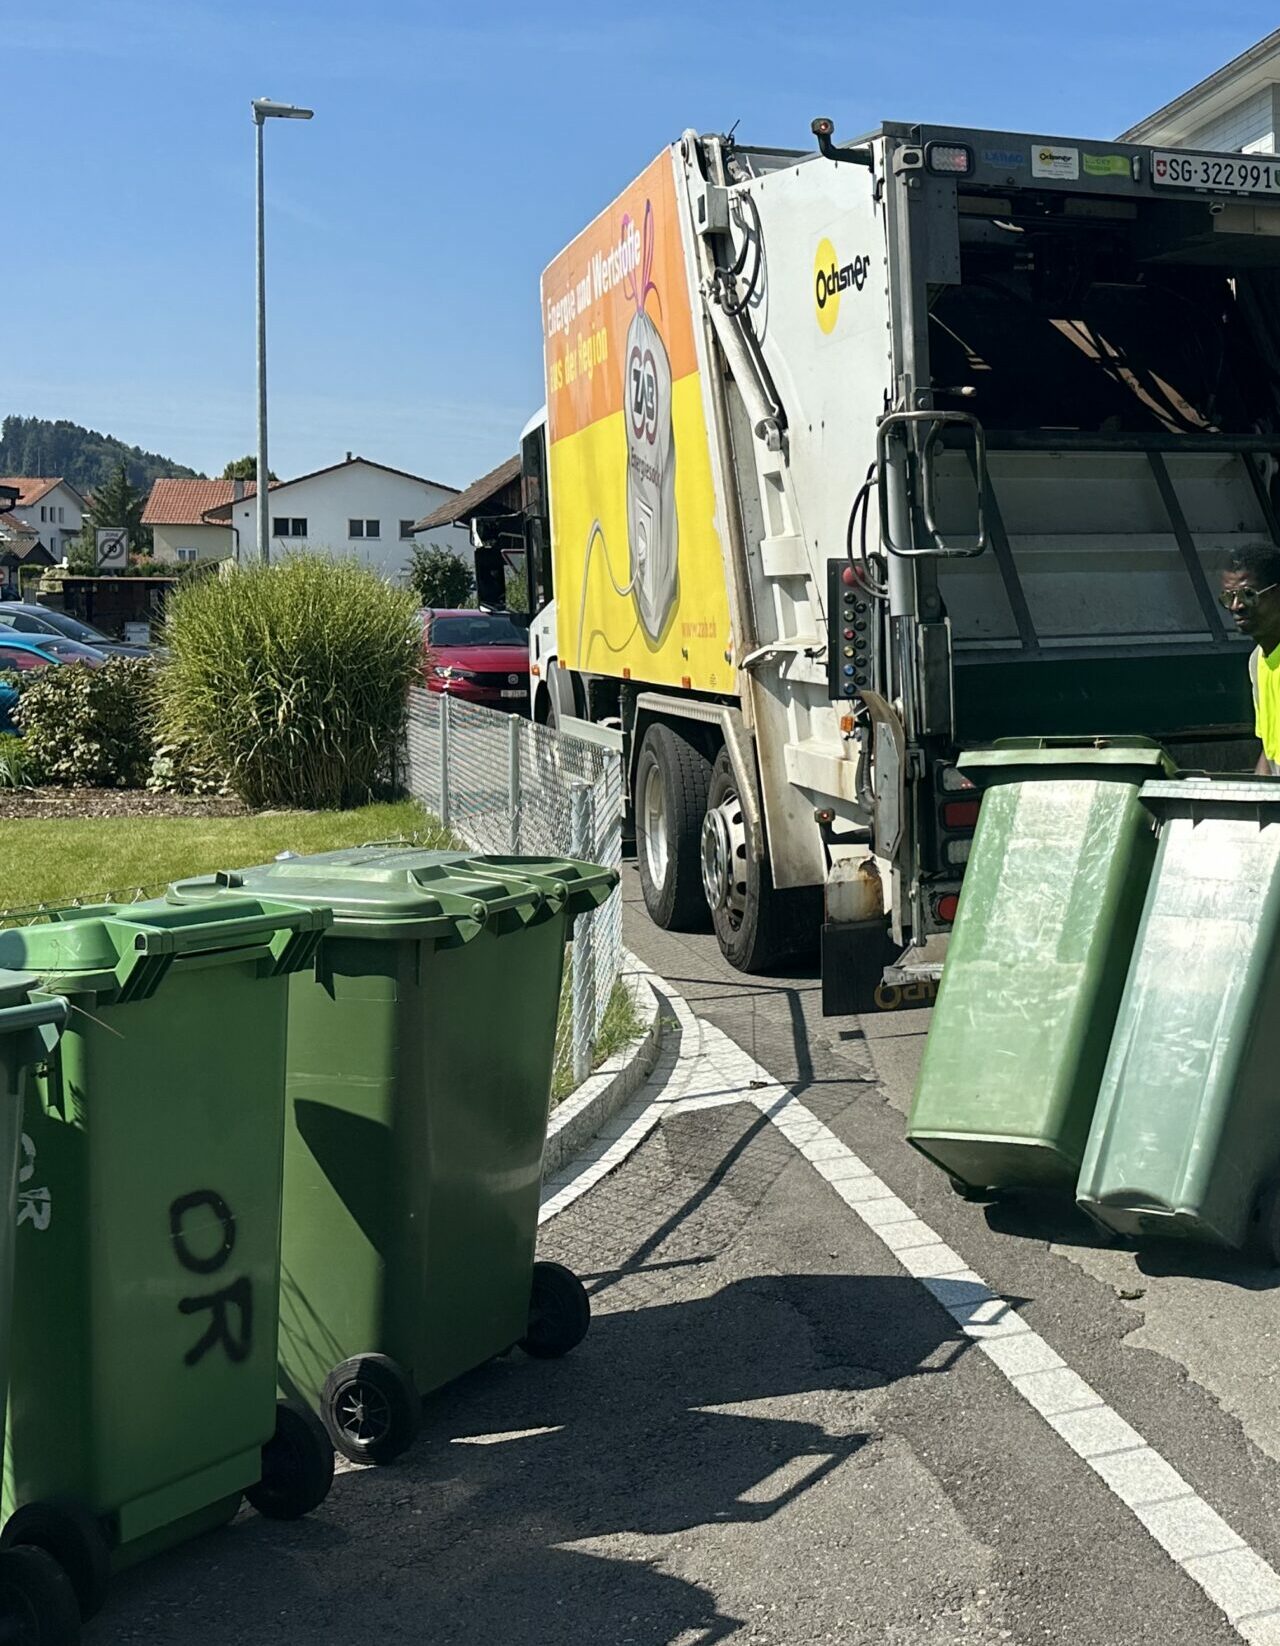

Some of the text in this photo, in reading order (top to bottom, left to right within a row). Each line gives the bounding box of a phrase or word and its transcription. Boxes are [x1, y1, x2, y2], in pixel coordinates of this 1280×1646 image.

[547, 219, 641, 338] Energie und Wertstoffe
[816, 255, 870, 309] Ochsner
[564, 342, 577, 385] der
[577, 321, 608, 381] Region
[169, 1189, 253, 1367] OR
